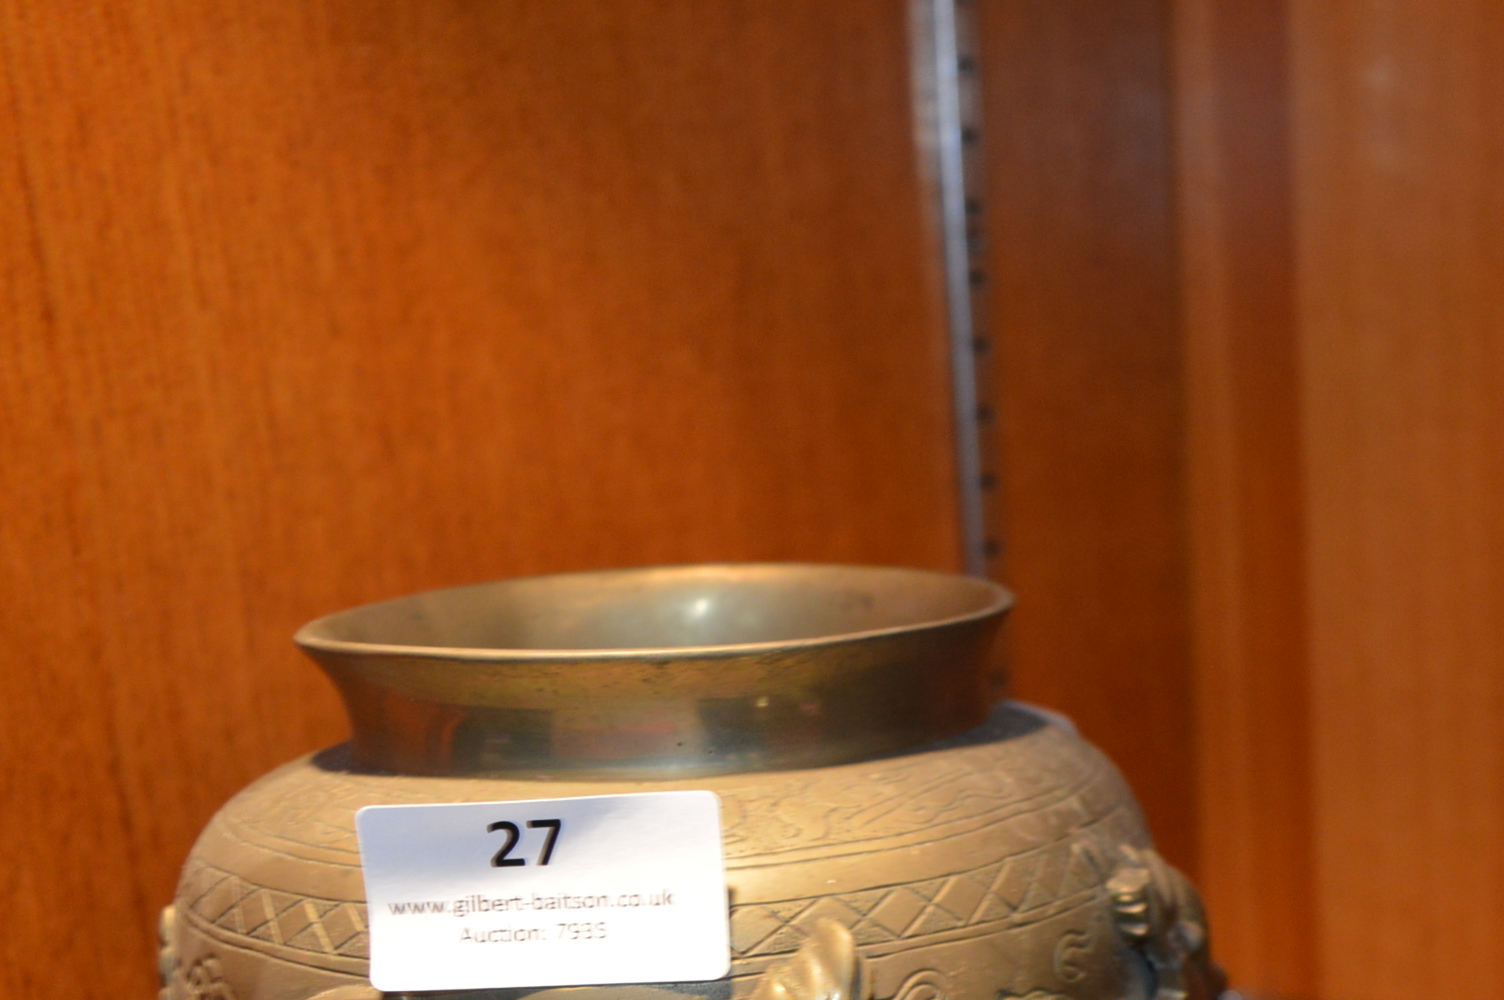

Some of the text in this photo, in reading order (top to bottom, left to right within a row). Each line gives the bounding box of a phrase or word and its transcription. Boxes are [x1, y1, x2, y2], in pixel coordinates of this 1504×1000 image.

[486, 818, 562, 868] 27
[387, 888, 675, 918] www.gilbert-baitson.co.uk
[459, 926, 547, 944] Auction:
